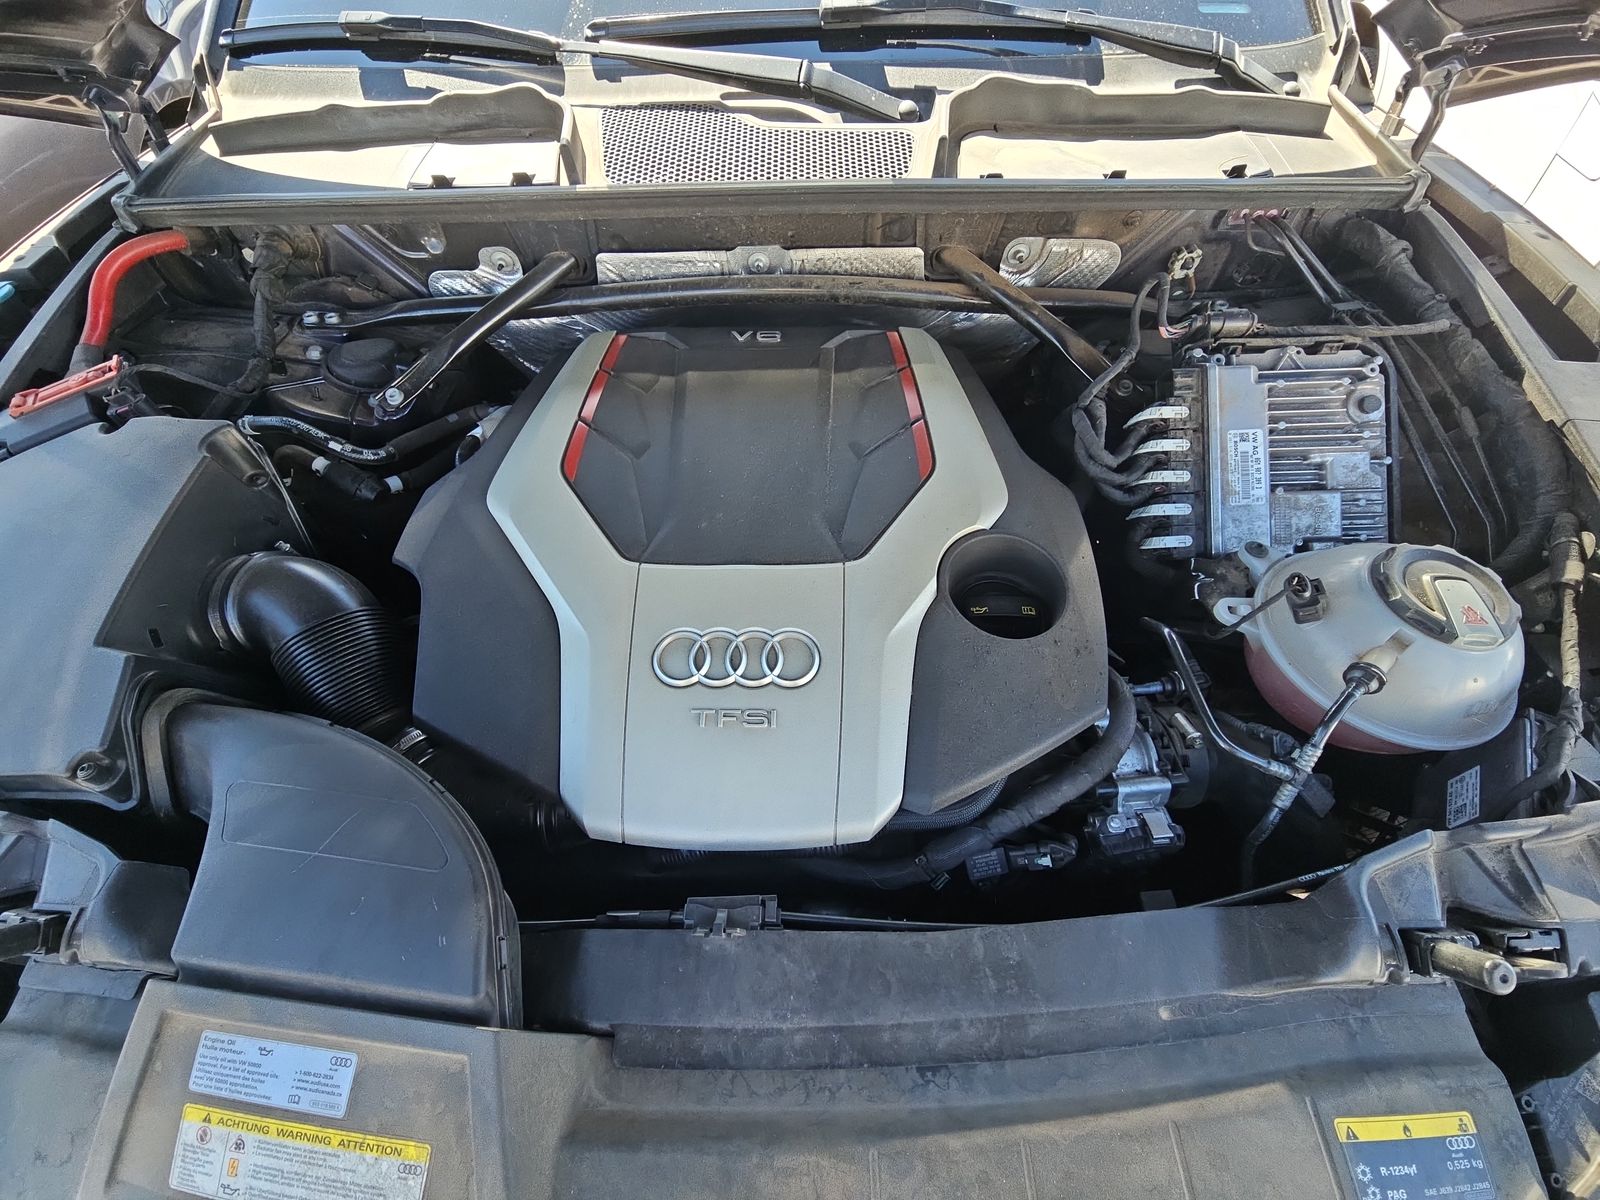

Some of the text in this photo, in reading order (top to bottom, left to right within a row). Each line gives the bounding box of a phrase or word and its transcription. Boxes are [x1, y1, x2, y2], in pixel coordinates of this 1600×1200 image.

[731, 330, 781, 342] V6
[1252, 432, 1258, 444] VW
[1252, 446, 1258, 456] AG
[690, 708, 777, 729] TFSI
[203, 1036, 225, 1044] Engine
[246, 1069, 268, 1078] approved
[217, 1117, 270, 1135] ACHTUNG
[276, 1128, 332, 1146] WARNING
[337, 1139, 402, 1157] ATTENTION
[1380, 1164, 1418, 1176] R-1234yf
[1447, 1159, 1484, 1170] 0,525 kg
[1387, 1189, 1408, 1199] PAG
[1424, 1188, 1438, 1196] SAE
